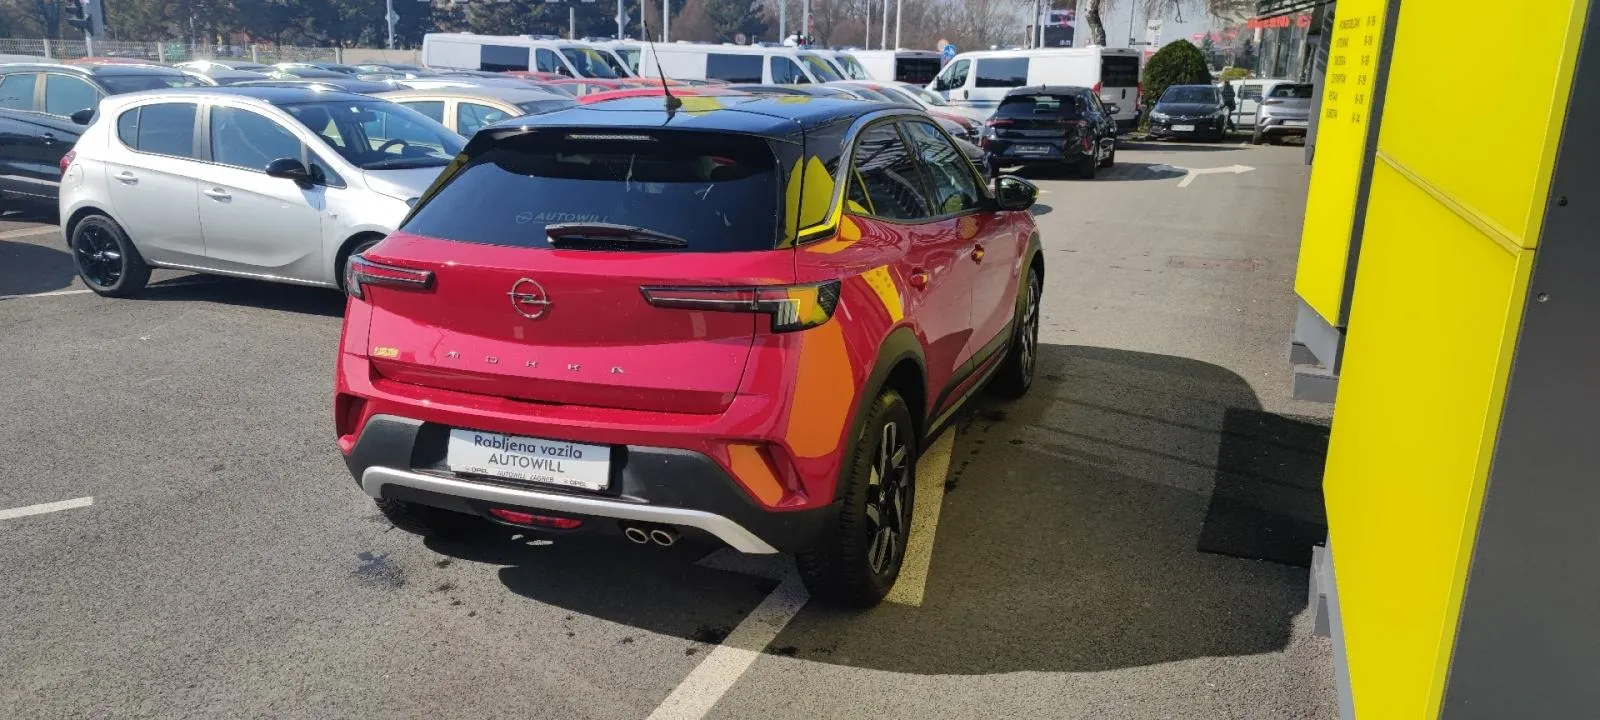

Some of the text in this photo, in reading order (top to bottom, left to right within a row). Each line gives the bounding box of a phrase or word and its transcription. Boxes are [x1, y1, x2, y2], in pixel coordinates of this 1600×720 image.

[474, 434, 583, 459] Rabljena vozila
[488, 453, 565, 473] AUTOWILL
